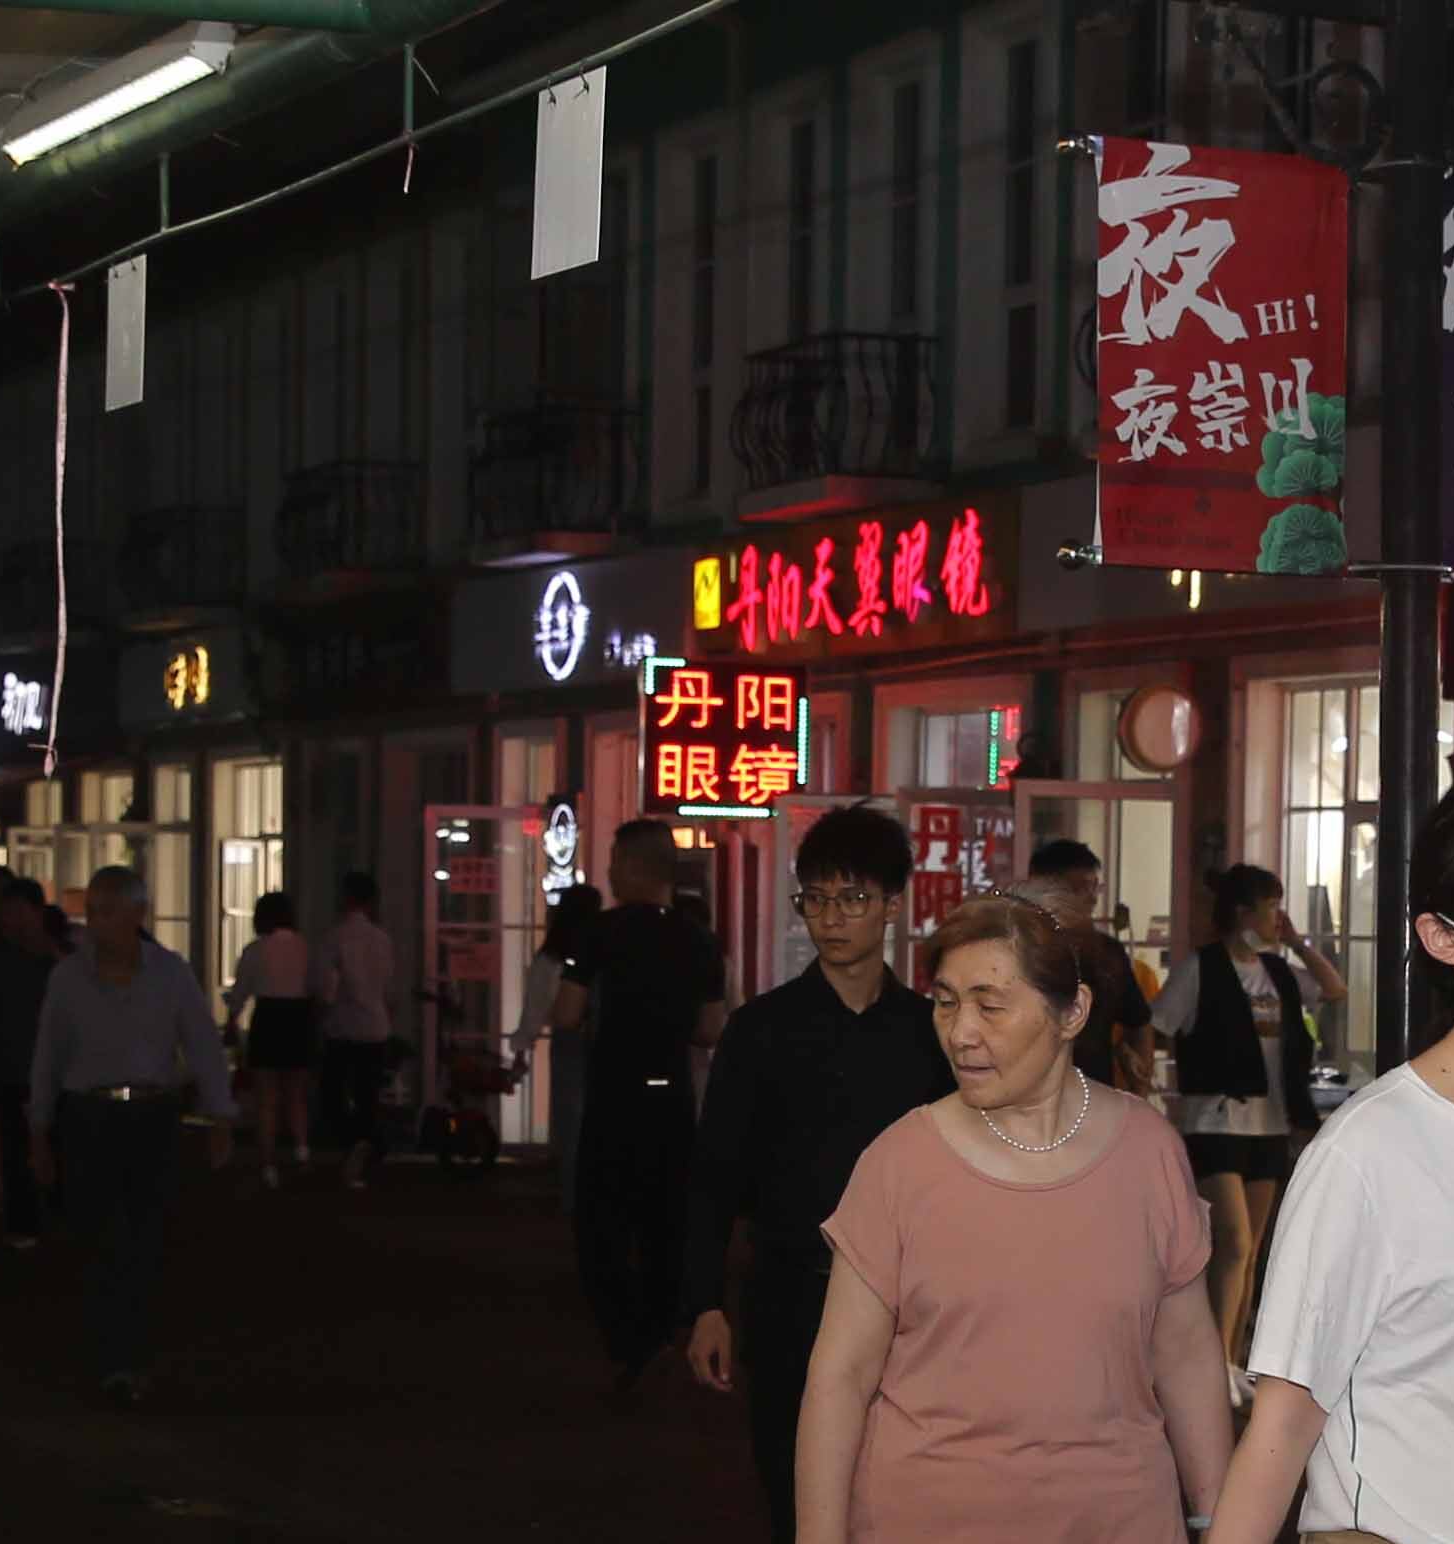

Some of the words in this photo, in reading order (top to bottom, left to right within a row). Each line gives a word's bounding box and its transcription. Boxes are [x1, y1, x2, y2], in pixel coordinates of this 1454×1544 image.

[1096, 142, 1245, 346] 夜
[1110, 357, 1317, 463] 夜崇川
[655, 671, 797, 733] 丹阳
[656, 742, 799, 804] 眼镜
